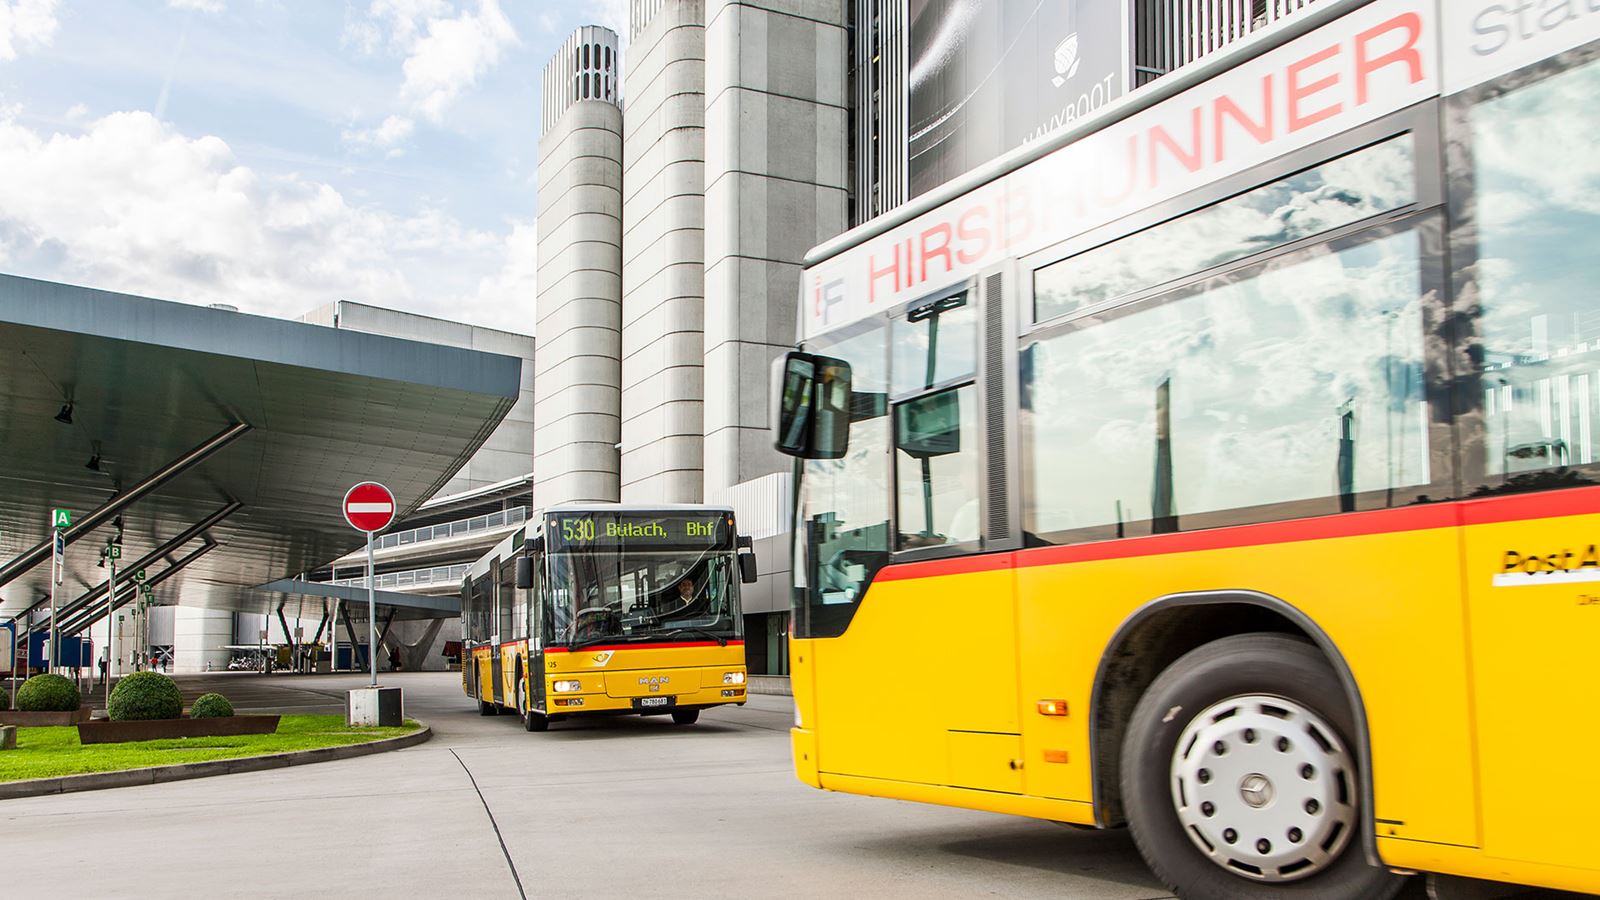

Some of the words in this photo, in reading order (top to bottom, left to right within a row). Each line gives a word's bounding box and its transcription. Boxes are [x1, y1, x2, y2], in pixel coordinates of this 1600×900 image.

[867, 11, 1426, 304] HIRSBUNNER
[58, 512, 68, 524] A
[563, 519, 595, 541] 530
[606, 522, 668, 539] Bülach,
[686, 521, 714, 536] Bhf
[112, 548, 119, 557] B
[137, 570, 144, 579] C
[639, 676, 669, 685] MAN
